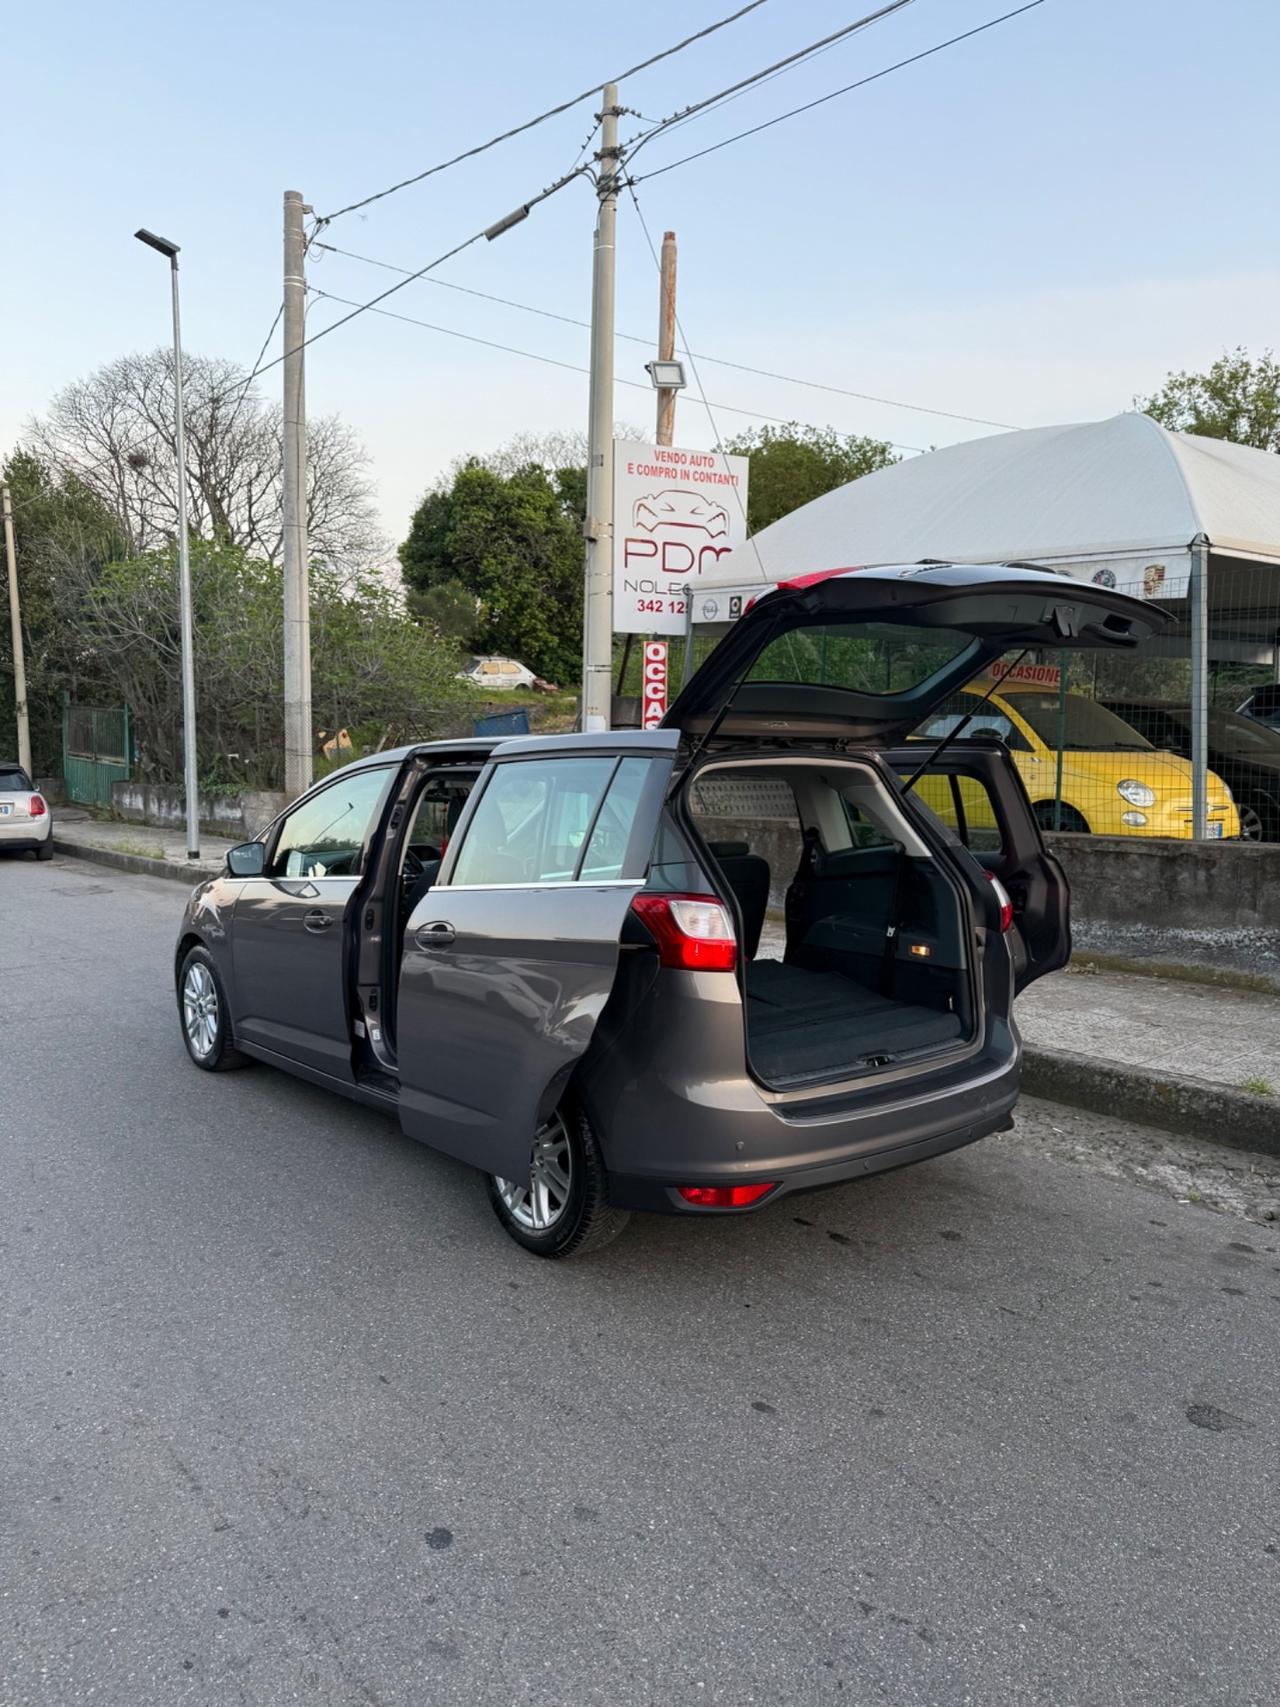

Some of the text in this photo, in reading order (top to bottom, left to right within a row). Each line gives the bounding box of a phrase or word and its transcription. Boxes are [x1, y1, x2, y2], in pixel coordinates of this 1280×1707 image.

[654, 450, 715, 468] VENDO AUTO
[627, 463, 739, 486] E COMPRO IN CONTANTI
[637, 599, 663, 613] 342
[668, 601, 688, 614] 12
